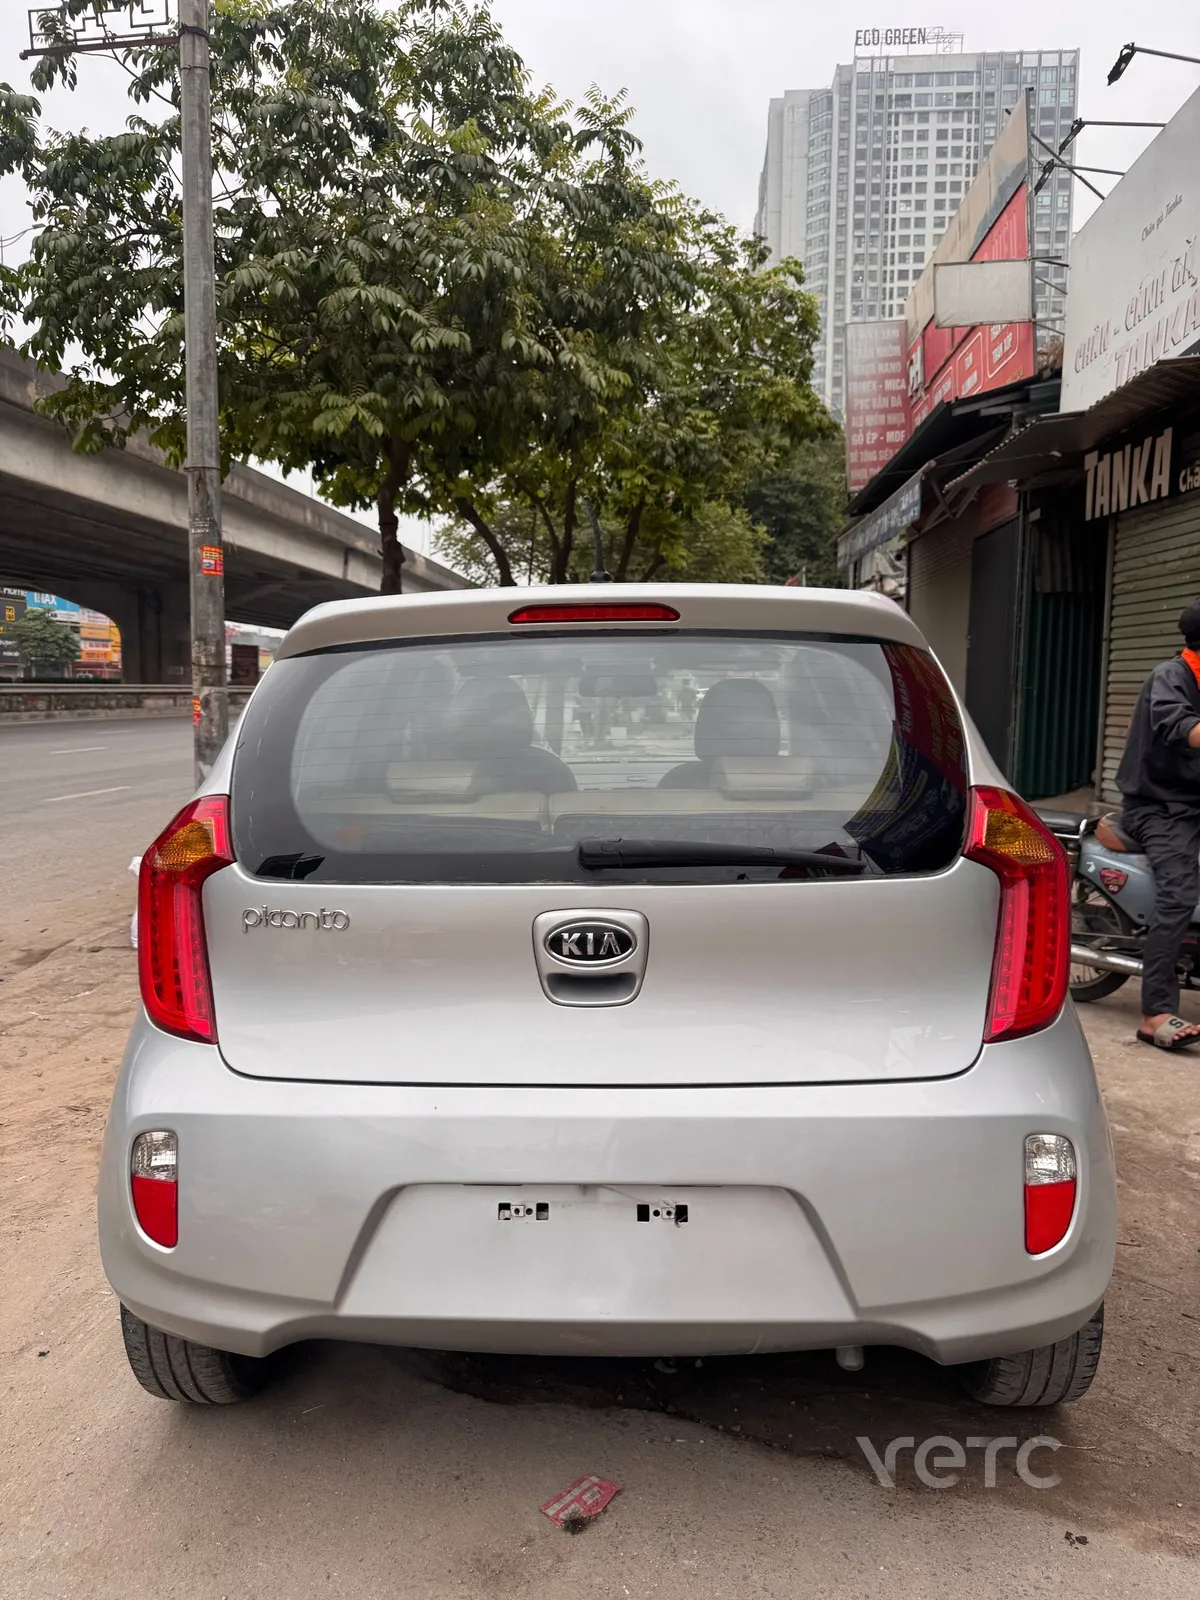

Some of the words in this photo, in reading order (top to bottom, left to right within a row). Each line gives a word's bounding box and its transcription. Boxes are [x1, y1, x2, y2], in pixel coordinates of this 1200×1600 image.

[855, 29, 881, 46] ECO
[885, 28, 927, 45] GREEN
[884, 378, 906, 391] MICA
[853, 398, 870, 411] PVC
[851, 429, 864, 446] GỖ
[865, 430, 878, 444] ÉP
[885, 430, 906, 443] MDF
[1084, 427, 1173, 521] TANKA
[242, 904, 350, 934] picanto
[561, 931, 621, 956] KIA
